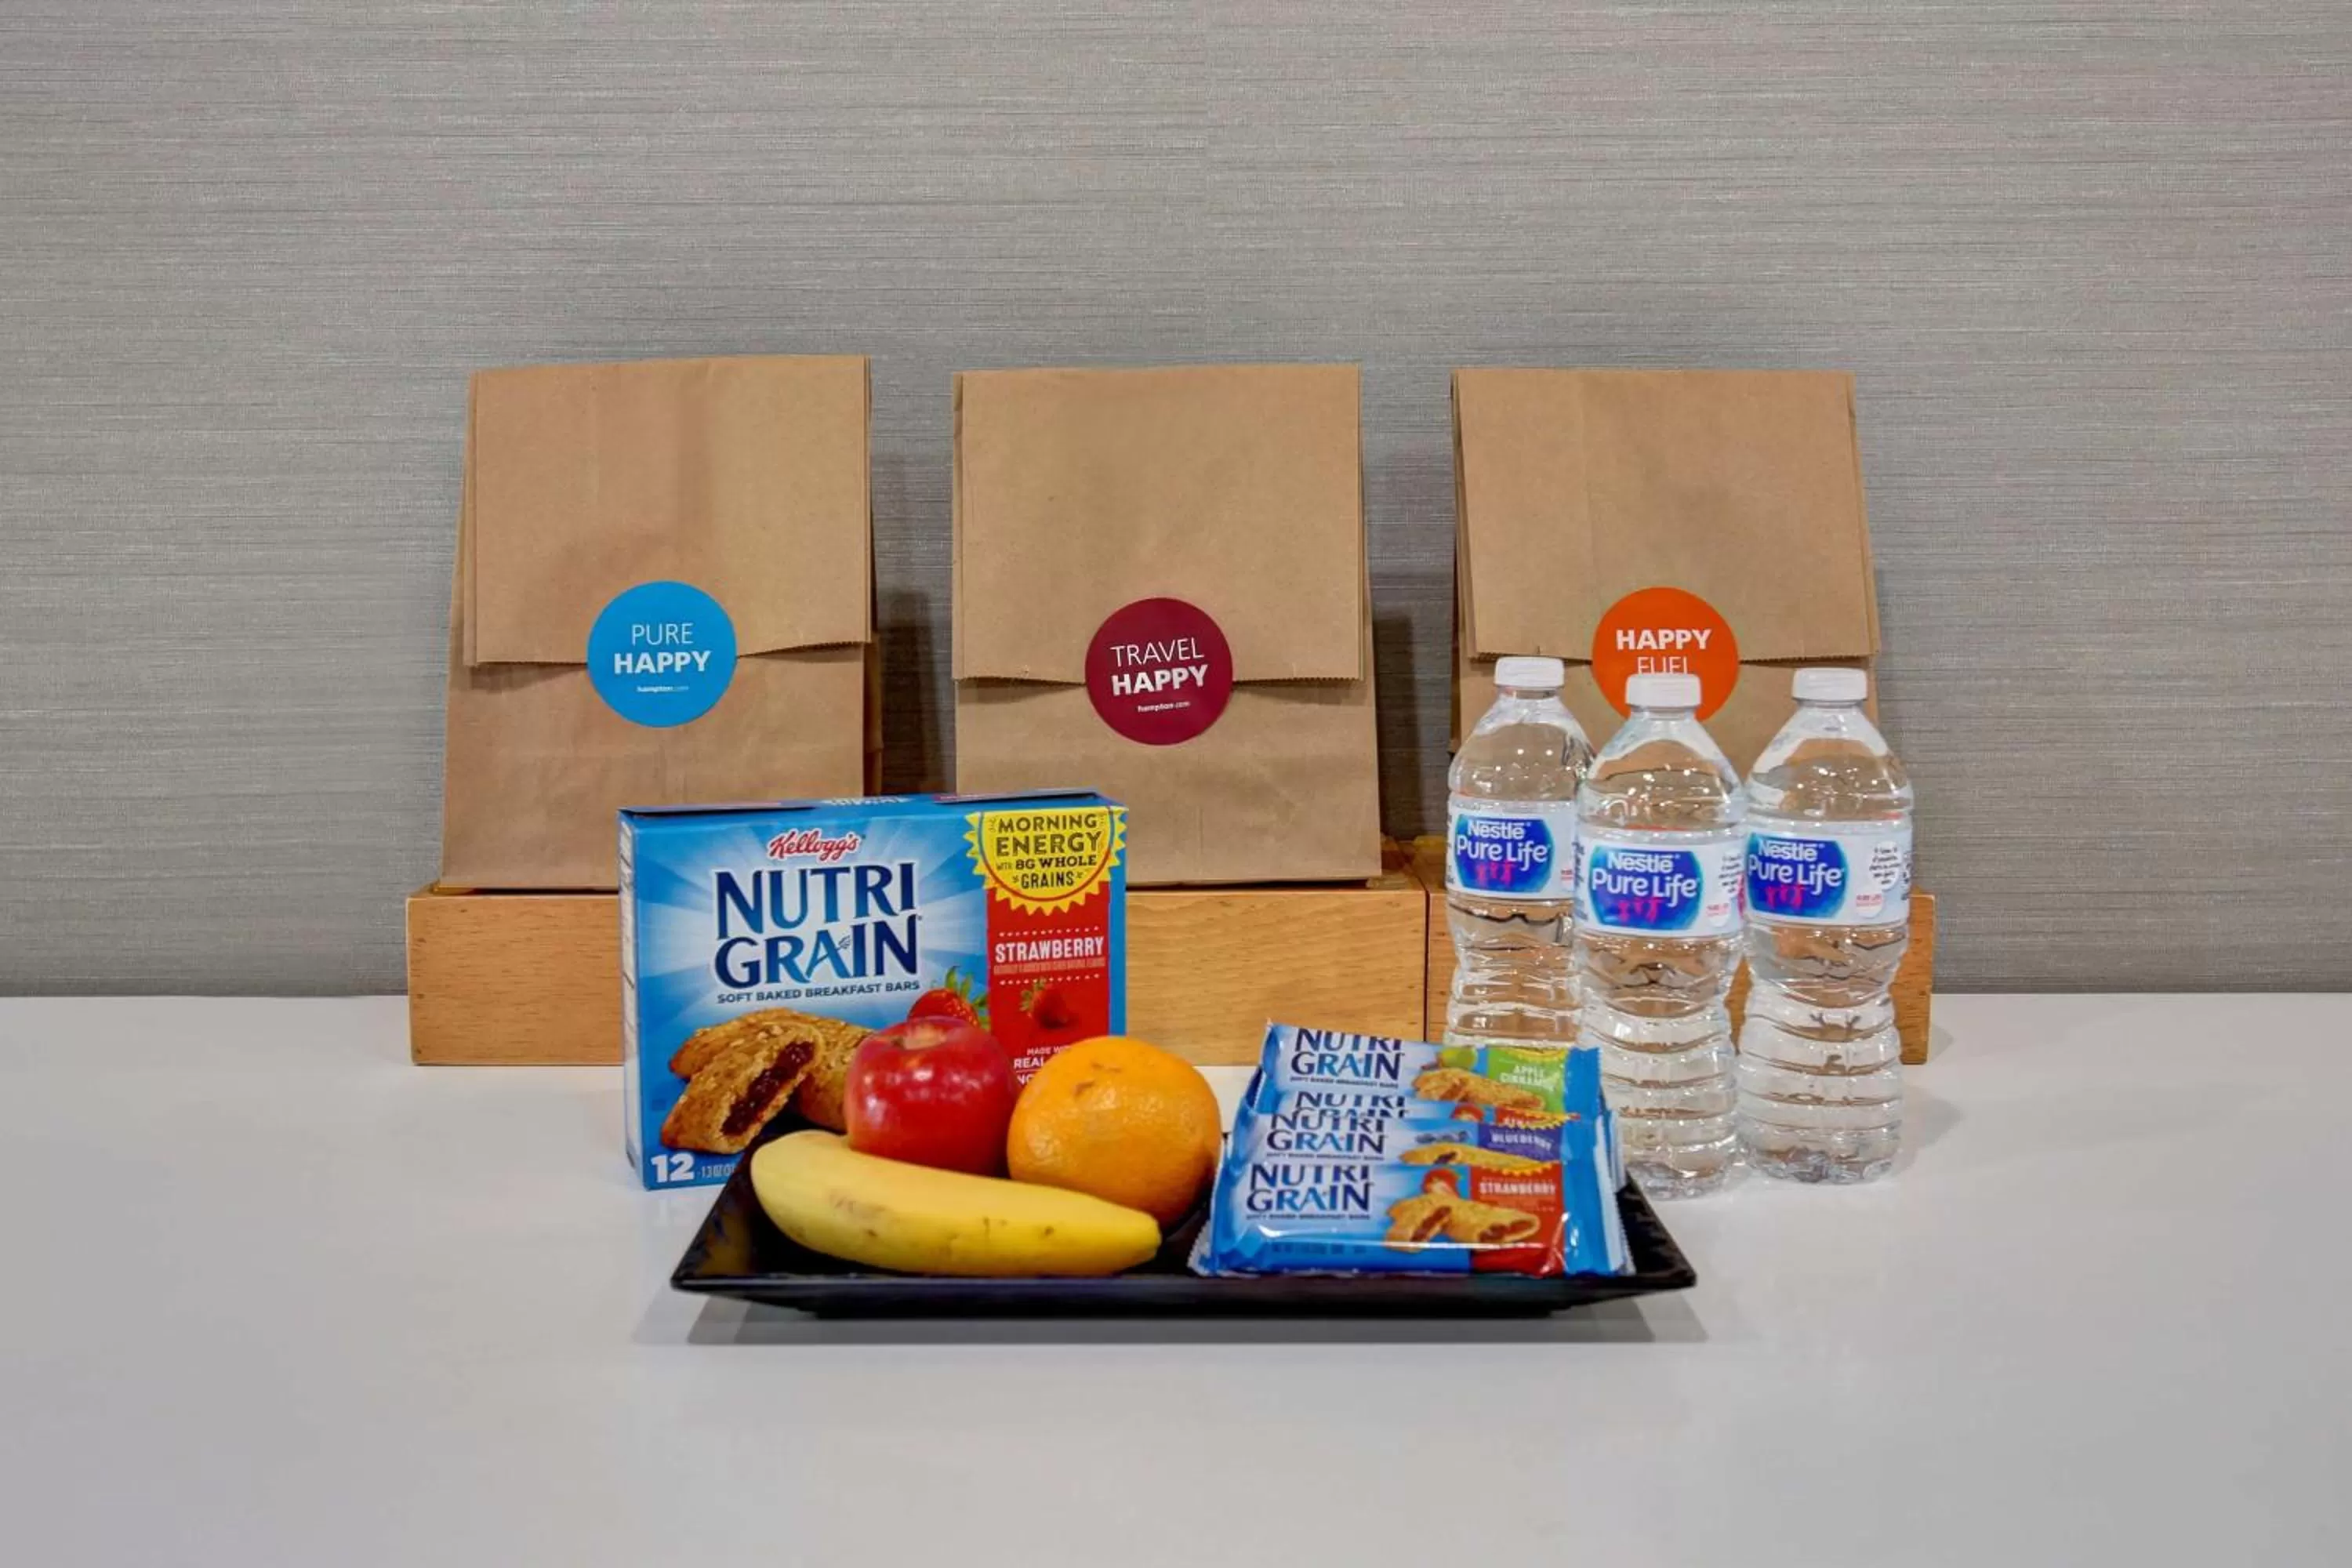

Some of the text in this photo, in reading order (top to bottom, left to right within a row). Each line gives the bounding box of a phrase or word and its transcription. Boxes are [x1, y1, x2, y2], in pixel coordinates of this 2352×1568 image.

[631, 622, 694, 646] PURE
[1615, 629, 1712, 651] HAPPY
[614, 650, 712, 675] HAPPY
[1110, 637, 1204, 667] TRAVEL
[1111, 665, 1208, 696] HAPPY
[1138, 701, 1190, 713] hampton.com
[998, 814, 1097, 834] MORNING
[769, 829, 858, 861] Kellogg's
[996, 831, 1102, 857] ENERGY
[1457, 834, 1502, 860] Pure
[1507, 840, 1547, 871] Life
[1038, 855, 1097, 868] WHOLE
[1748, 855, 1793, 883] Pure
[1797, 863, 1842, 895] Life
[1021, 871, 1075, 889] GRAINS
[1592, 868, 1697, 907] Pure Life
[713, 863, 916, 941] NUTRI
[714, 914, 918, 989] GRAIN
[995, 936, 1104, 964] STRAWBERRY
[717, 980, 920, 1004] SOFT BAKED BREAKFAST BARS
[1026, 1047, 1051, 1055] MADE
[1291, 1051, 1403, 1080] GRAIN
[1266, 1129, 1385, 1155] GRAIN
[651, 1151, 695, 1183] 12
[1250, 1163, 1370, 1191] NUTRI
[1246, 1184, 1370, 1213] GRAIN
[1479, 1182, 1556, 1195] STRAWBERRY
